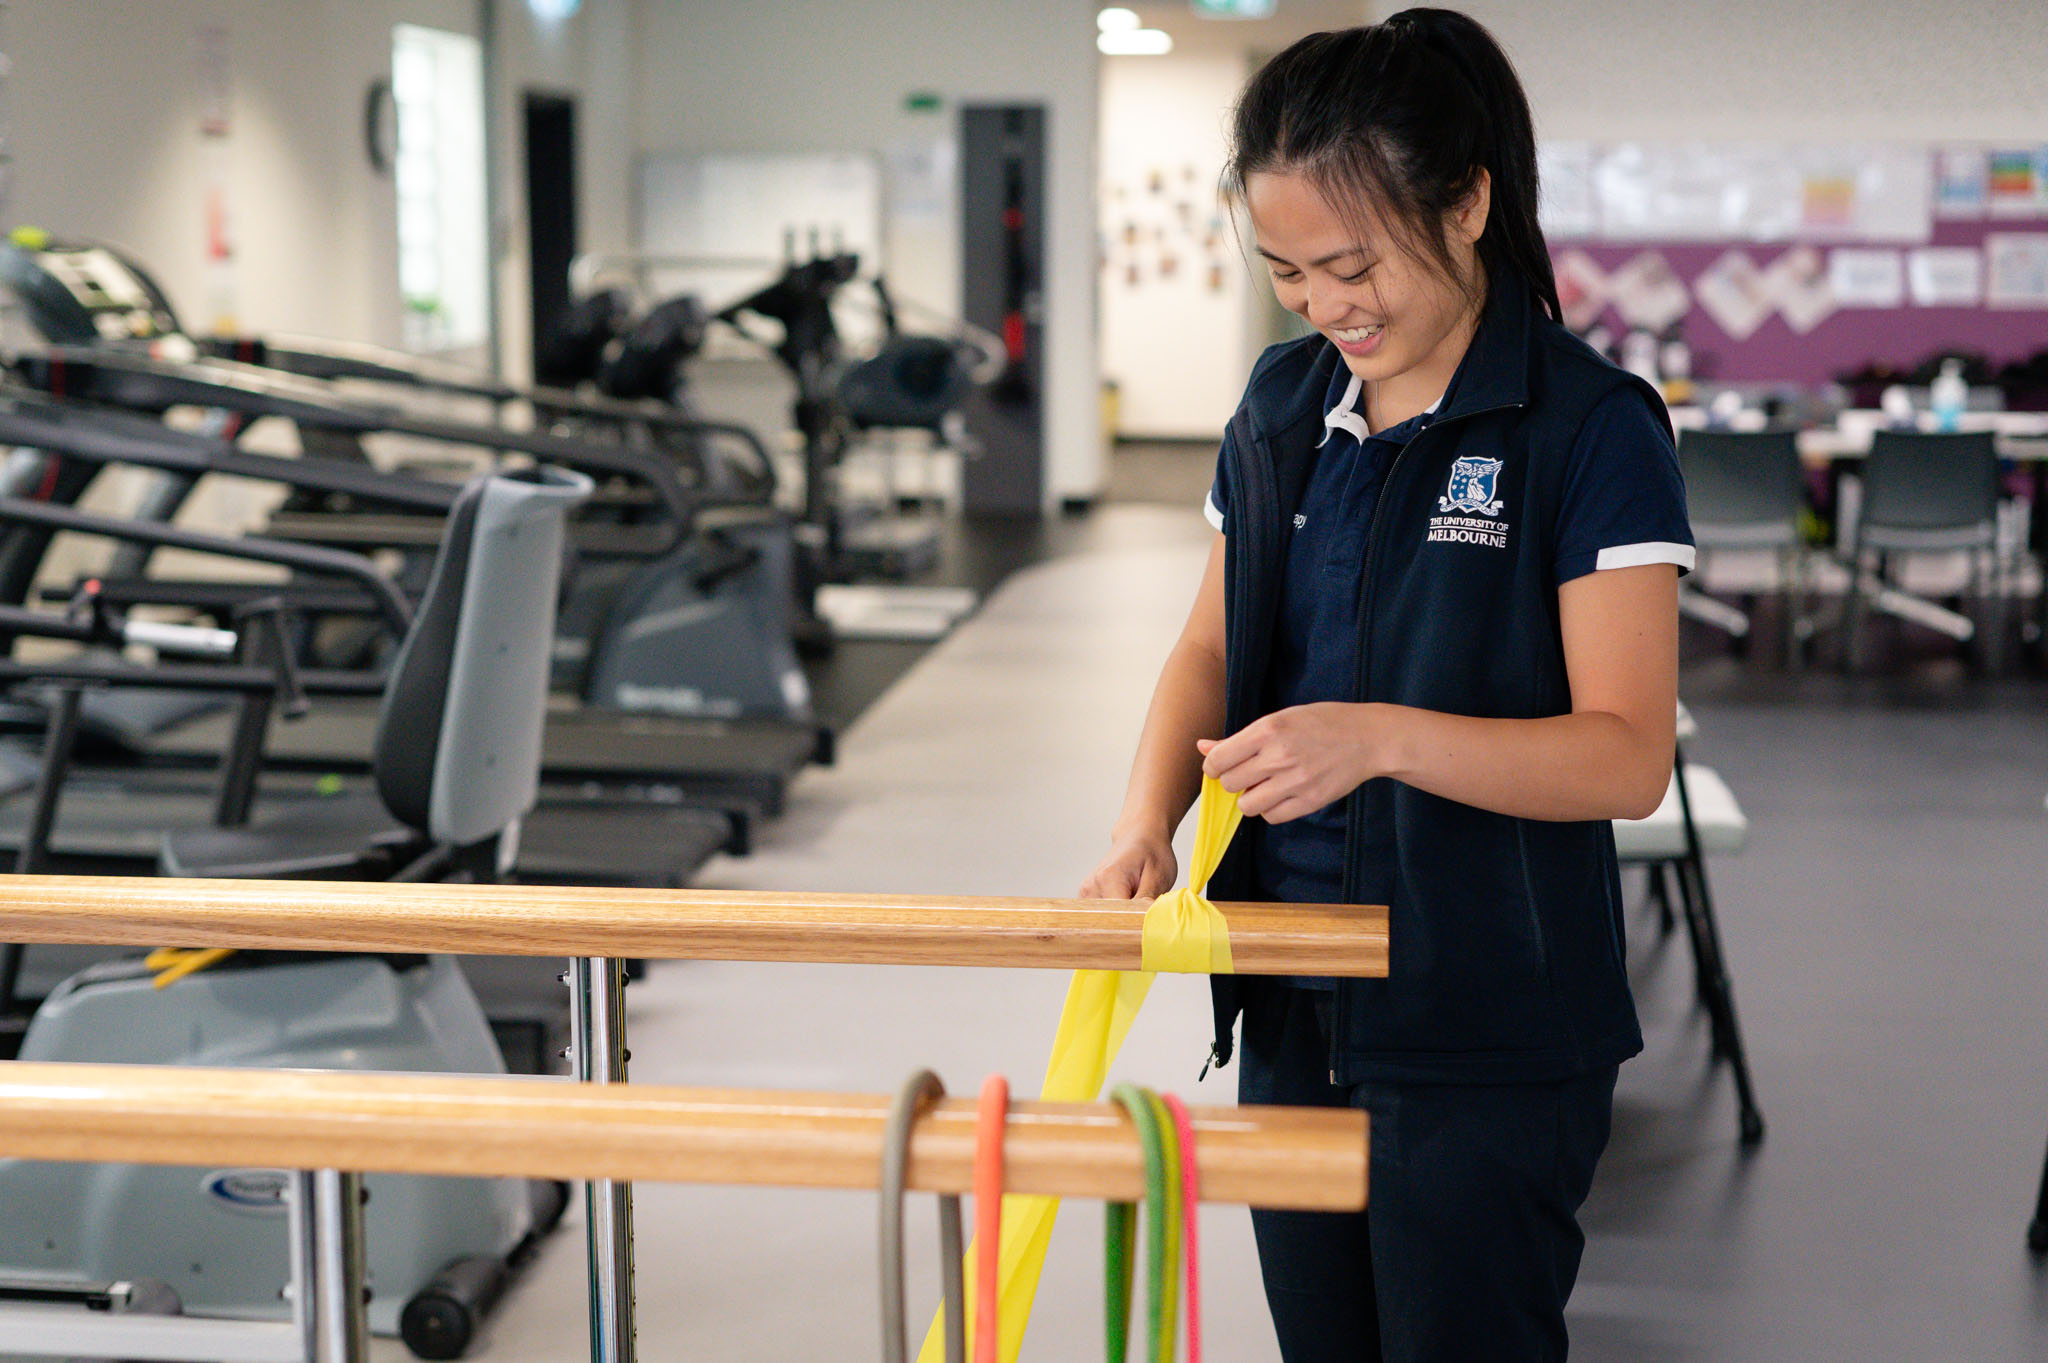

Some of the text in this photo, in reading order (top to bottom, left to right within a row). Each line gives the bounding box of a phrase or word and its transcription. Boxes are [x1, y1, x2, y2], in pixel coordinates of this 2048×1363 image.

[1430, 517, 1509, 531] THE UNIVERSITY OF
[1427, 530, 1506, 548] MELBOURNE
